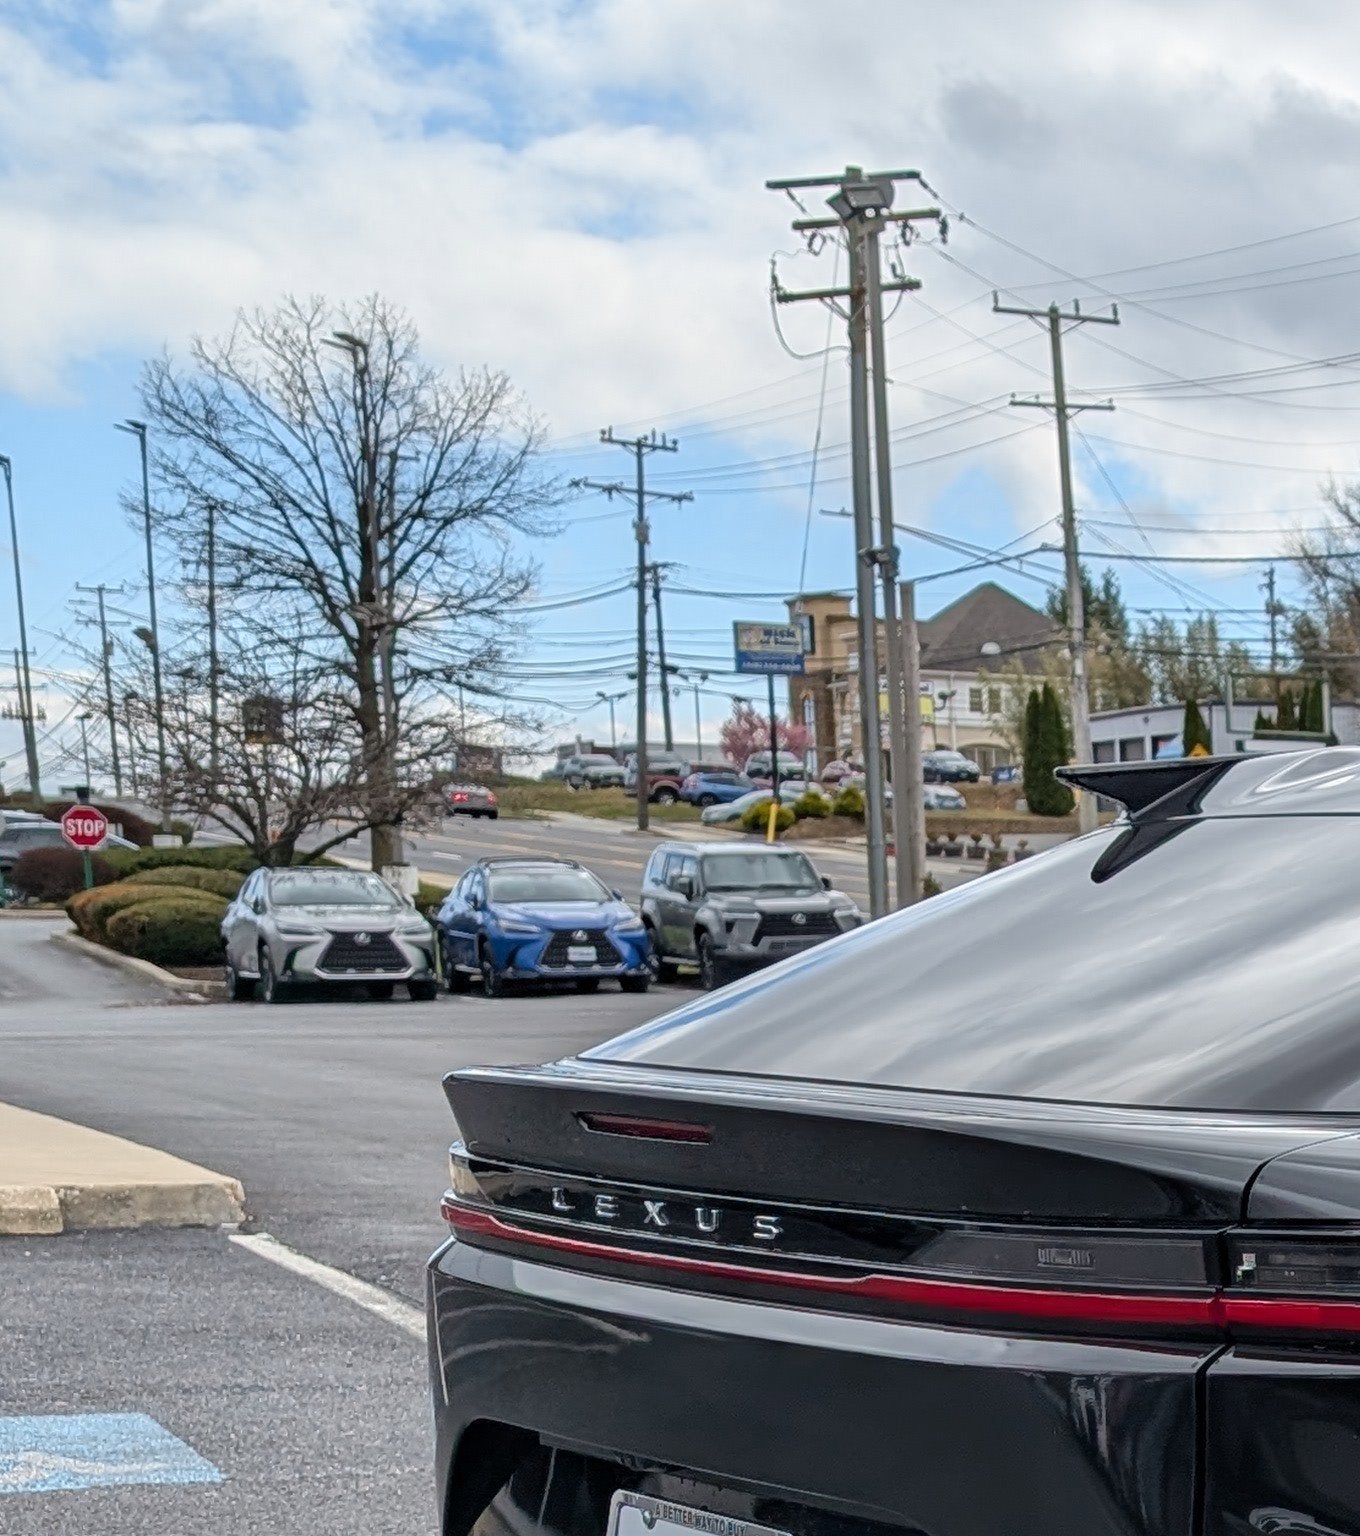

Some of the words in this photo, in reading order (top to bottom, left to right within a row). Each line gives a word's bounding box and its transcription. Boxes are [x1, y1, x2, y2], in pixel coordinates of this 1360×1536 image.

[66, 818, 105, 837] STOP
[551, 1186, 785, 1240] LEXUS
[663, 1506, 694, 1525] BETTER
[694, 1514, 712, 1530] WAY
[714, 1519, 725, 1535] TO
